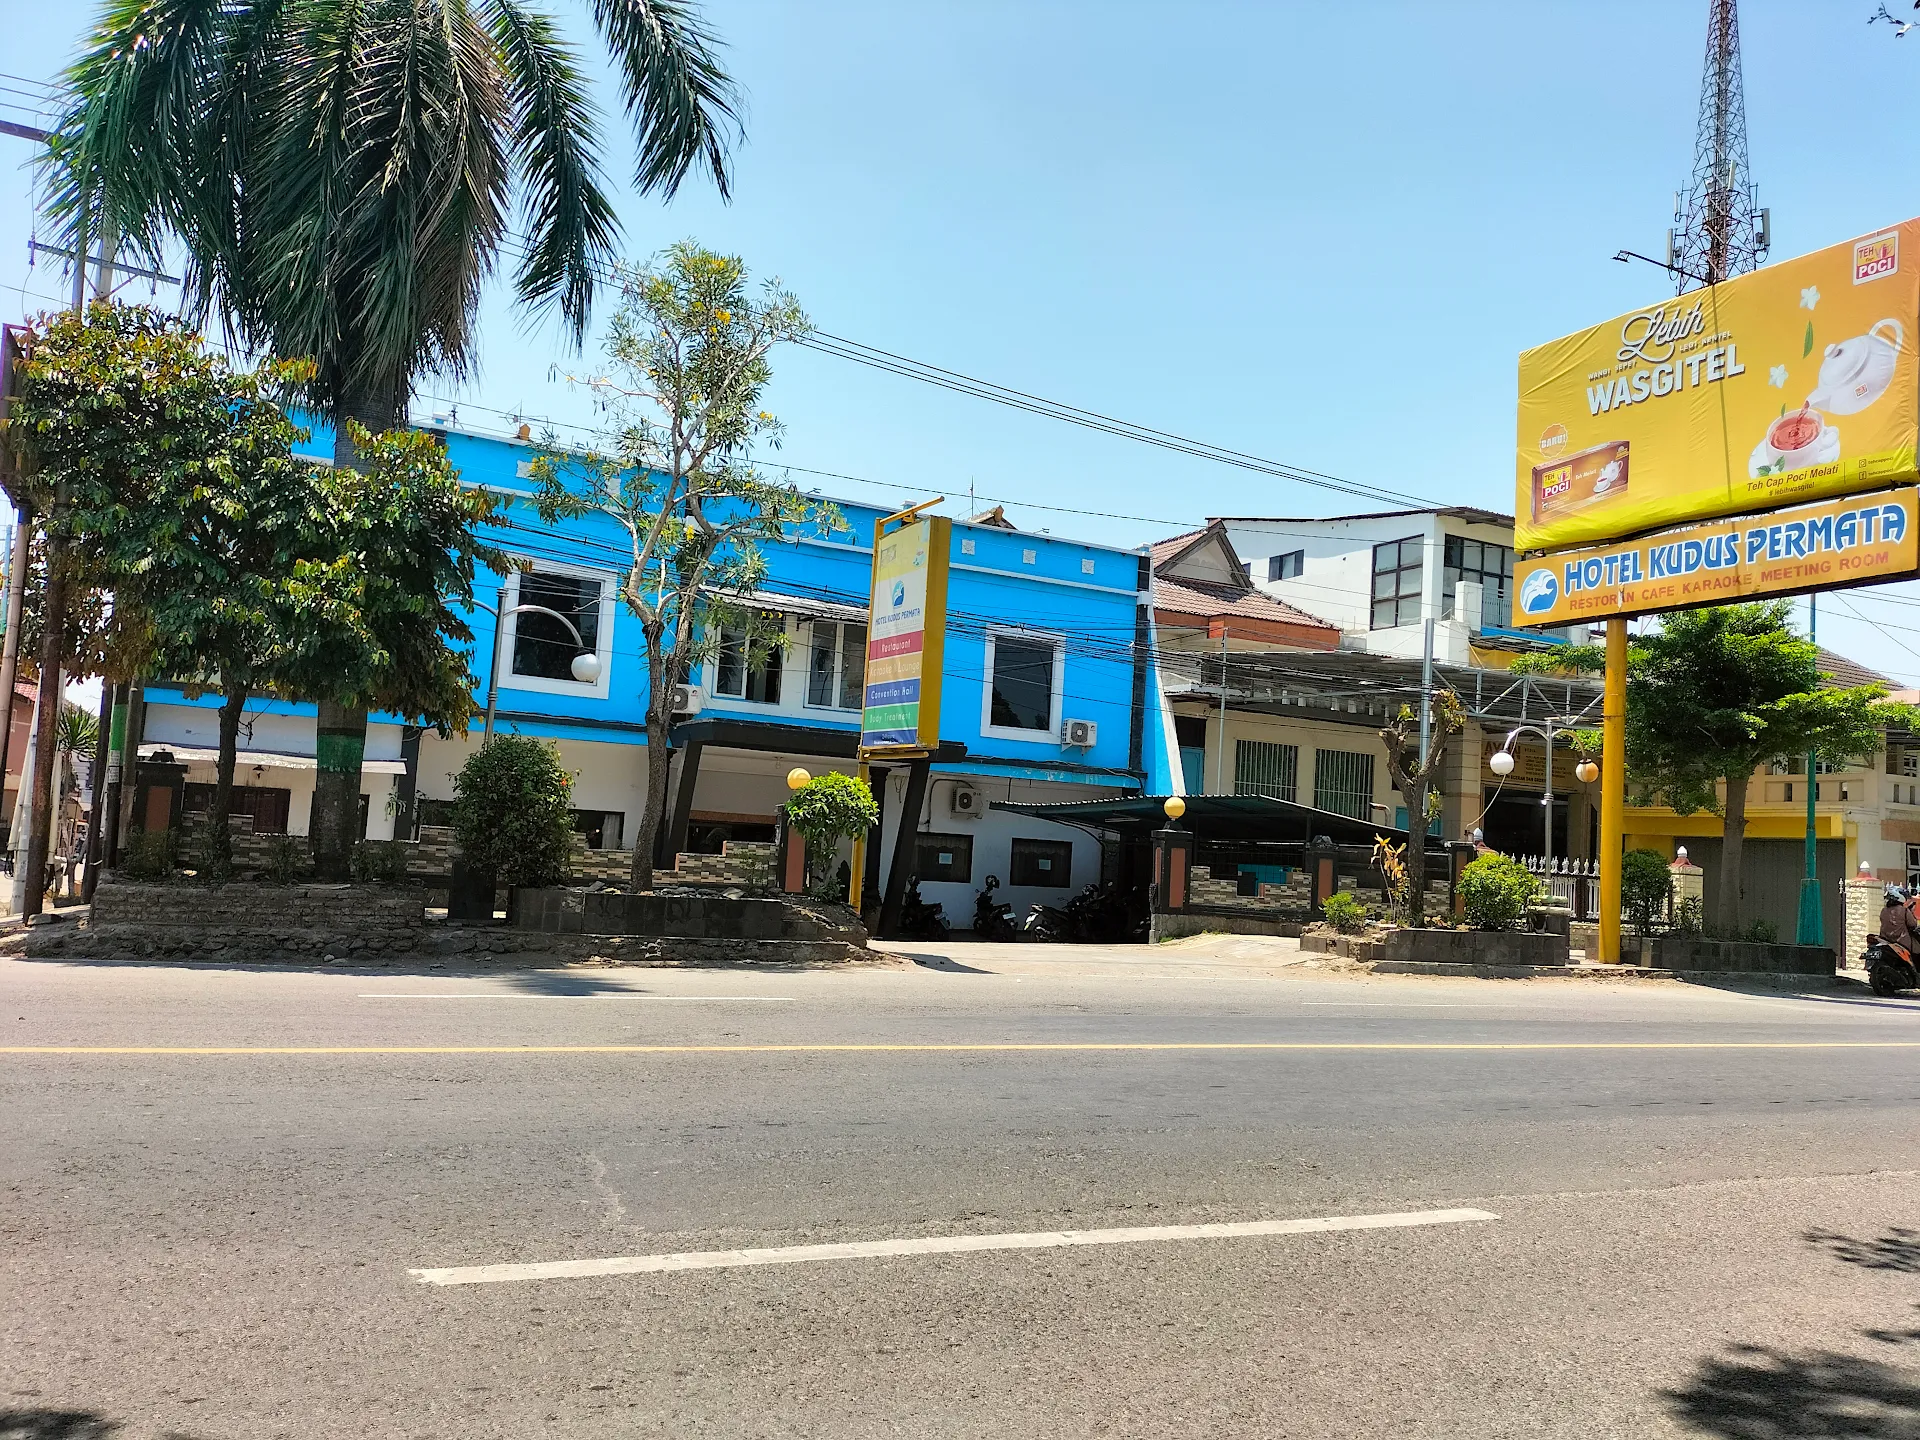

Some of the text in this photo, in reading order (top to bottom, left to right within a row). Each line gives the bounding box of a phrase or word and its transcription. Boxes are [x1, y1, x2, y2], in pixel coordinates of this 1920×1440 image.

[1859, 246, 1874, 259] TEH
[1858, 258, 1892, 278] POCI
[1616, 300, 1705, 364] Lebih
[1679, 330, 1733, 353] LEGI KENTEL
[1586, 343, 1745, 417] WASGITEL
[1587, 369, 1612, 382] WANGI
[1541, 433, 1567, 449] BARU!
[1544, 473, 1555, 482] TEH
[1747, 464, 1839, 492] Teh Cap Poci Melati
[1544, 480, 1570, 497] POCI
[1564, 503, 1907, 597] HOTEL KUDUS PERMATA
[1641, 585, 1675, 601] CAFE
[1682, 572, 1753, 595] KARAOKE
[1760, 560, 1832, 583] MEETING
[1839, 551, 1889, 571] ROOM
[875, 607, 921, 627] HOTEL KUDUS PERMATA
[881, 638, 911, 653] Restaurant
[869, 663, 893, 676] Karaoke
[897, 660, 920, 674] Lounge
[870, 685, 914, 700] Convention Hall
[869, 711, 911, 725] Body Treatment
